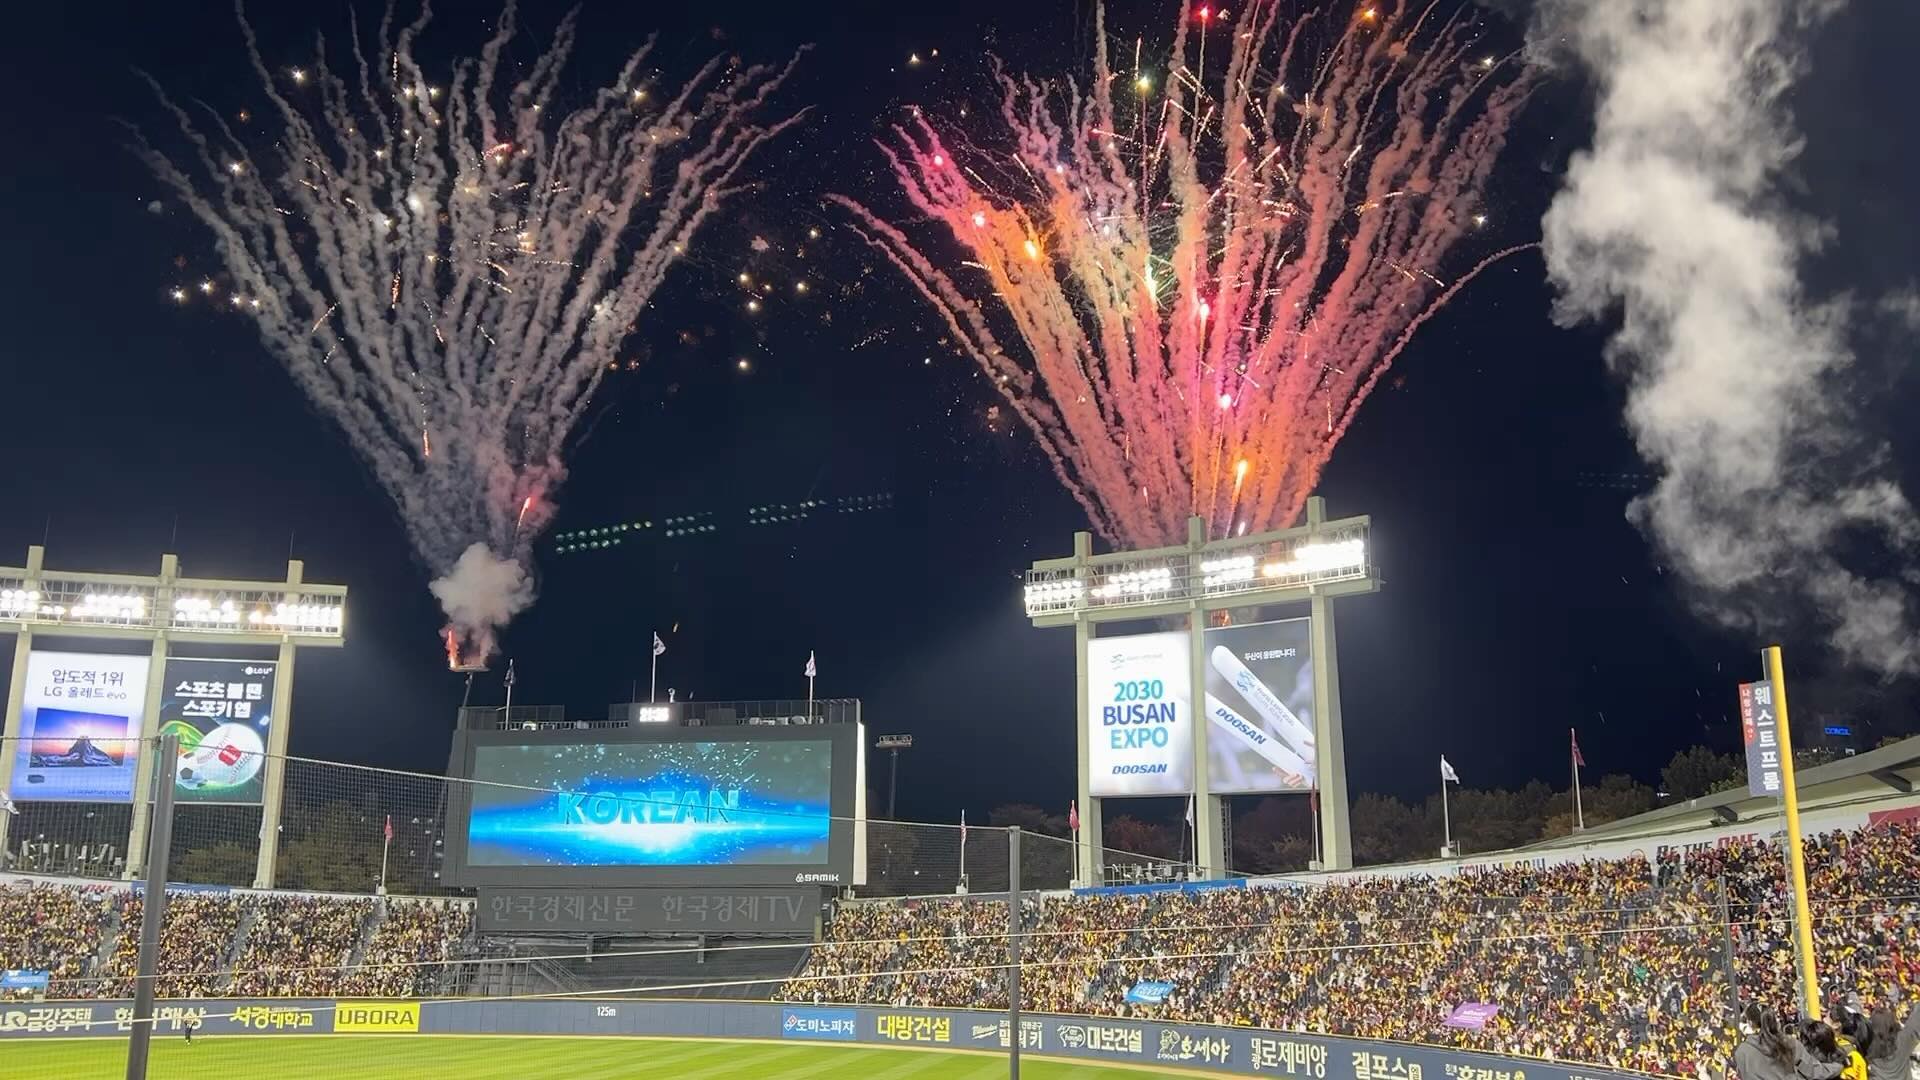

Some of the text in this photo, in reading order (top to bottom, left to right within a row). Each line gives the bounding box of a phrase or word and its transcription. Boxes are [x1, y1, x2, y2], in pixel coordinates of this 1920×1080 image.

[52, 669, 124, 686] 압도적 1위
[175, 681, 225, 698] 스포츠
[44, 686, 127, 700] LG 올레드 evo
[1114, 679, 1163, 702] 2030
[182, 700, 233, 718] 스포키
[1103, 702, 1176, 726] BUSAN
[1110, 726, 1169, 750] EXPO
[1215, 708, 1267, 746] DOOSAN
[1112, 763, 1168, 775] DOOSAN
[558, 790, 740, 825] KOREAN
[804, 873, 840, 882] SAMIK
[491, 895, 804, 922] 한국경제신문 한국경제TV
[28, 1007, 92, 1032] 금강주택
[115, 1007, 207, 1031] 현해상
[229, 1006, 314, 1030] 서경대학교
[338, 1010, 415, 1025] UBORA
[596, 1006, 616, 1018] 125m
[795, 1018, 855, 1035] 도미노피자
[877, 1015, 951, 1042] 대방건설
[1087, 1026, 1143, 1053] 대보건설
[1178, 1034, 1231, 1064] 호세야
[1261, 1039, 1328, 1079] 로제비앙
[1352, 1051, 1408, 1080] 겔포스
